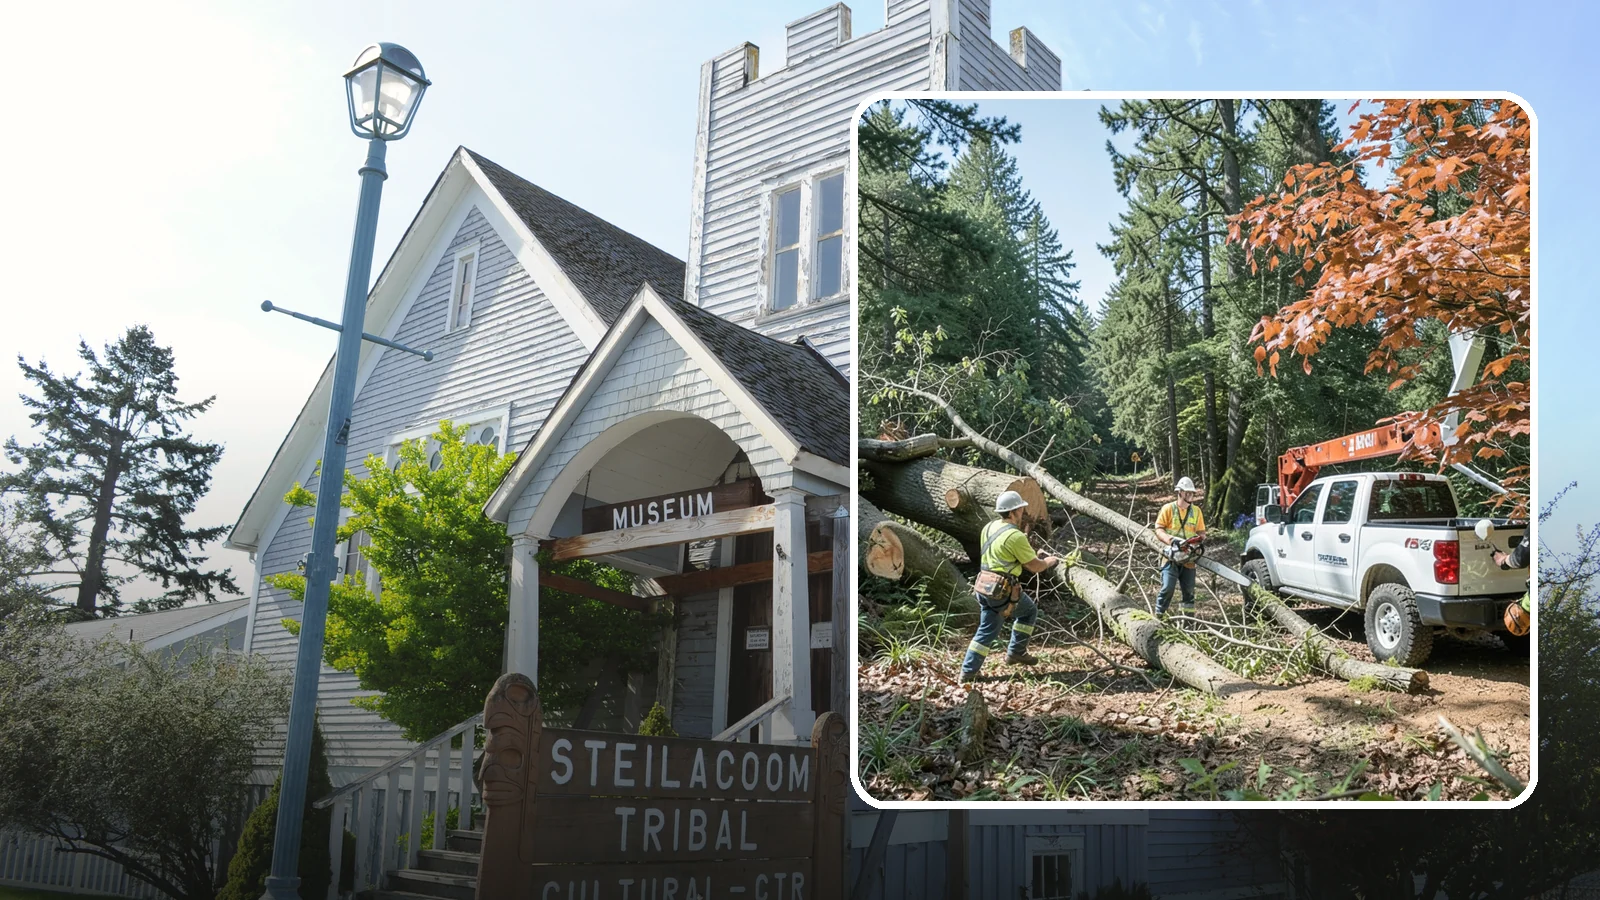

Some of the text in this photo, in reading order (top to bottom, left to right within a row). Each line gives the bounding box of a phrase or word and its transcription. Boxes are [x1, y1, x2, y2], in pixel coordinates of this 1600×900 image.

[613, 491, 713, 531] MUSEUM
[551, 738, 809, 792] STEILACOOM
[614, 806, 758, 851] TRIBAL
